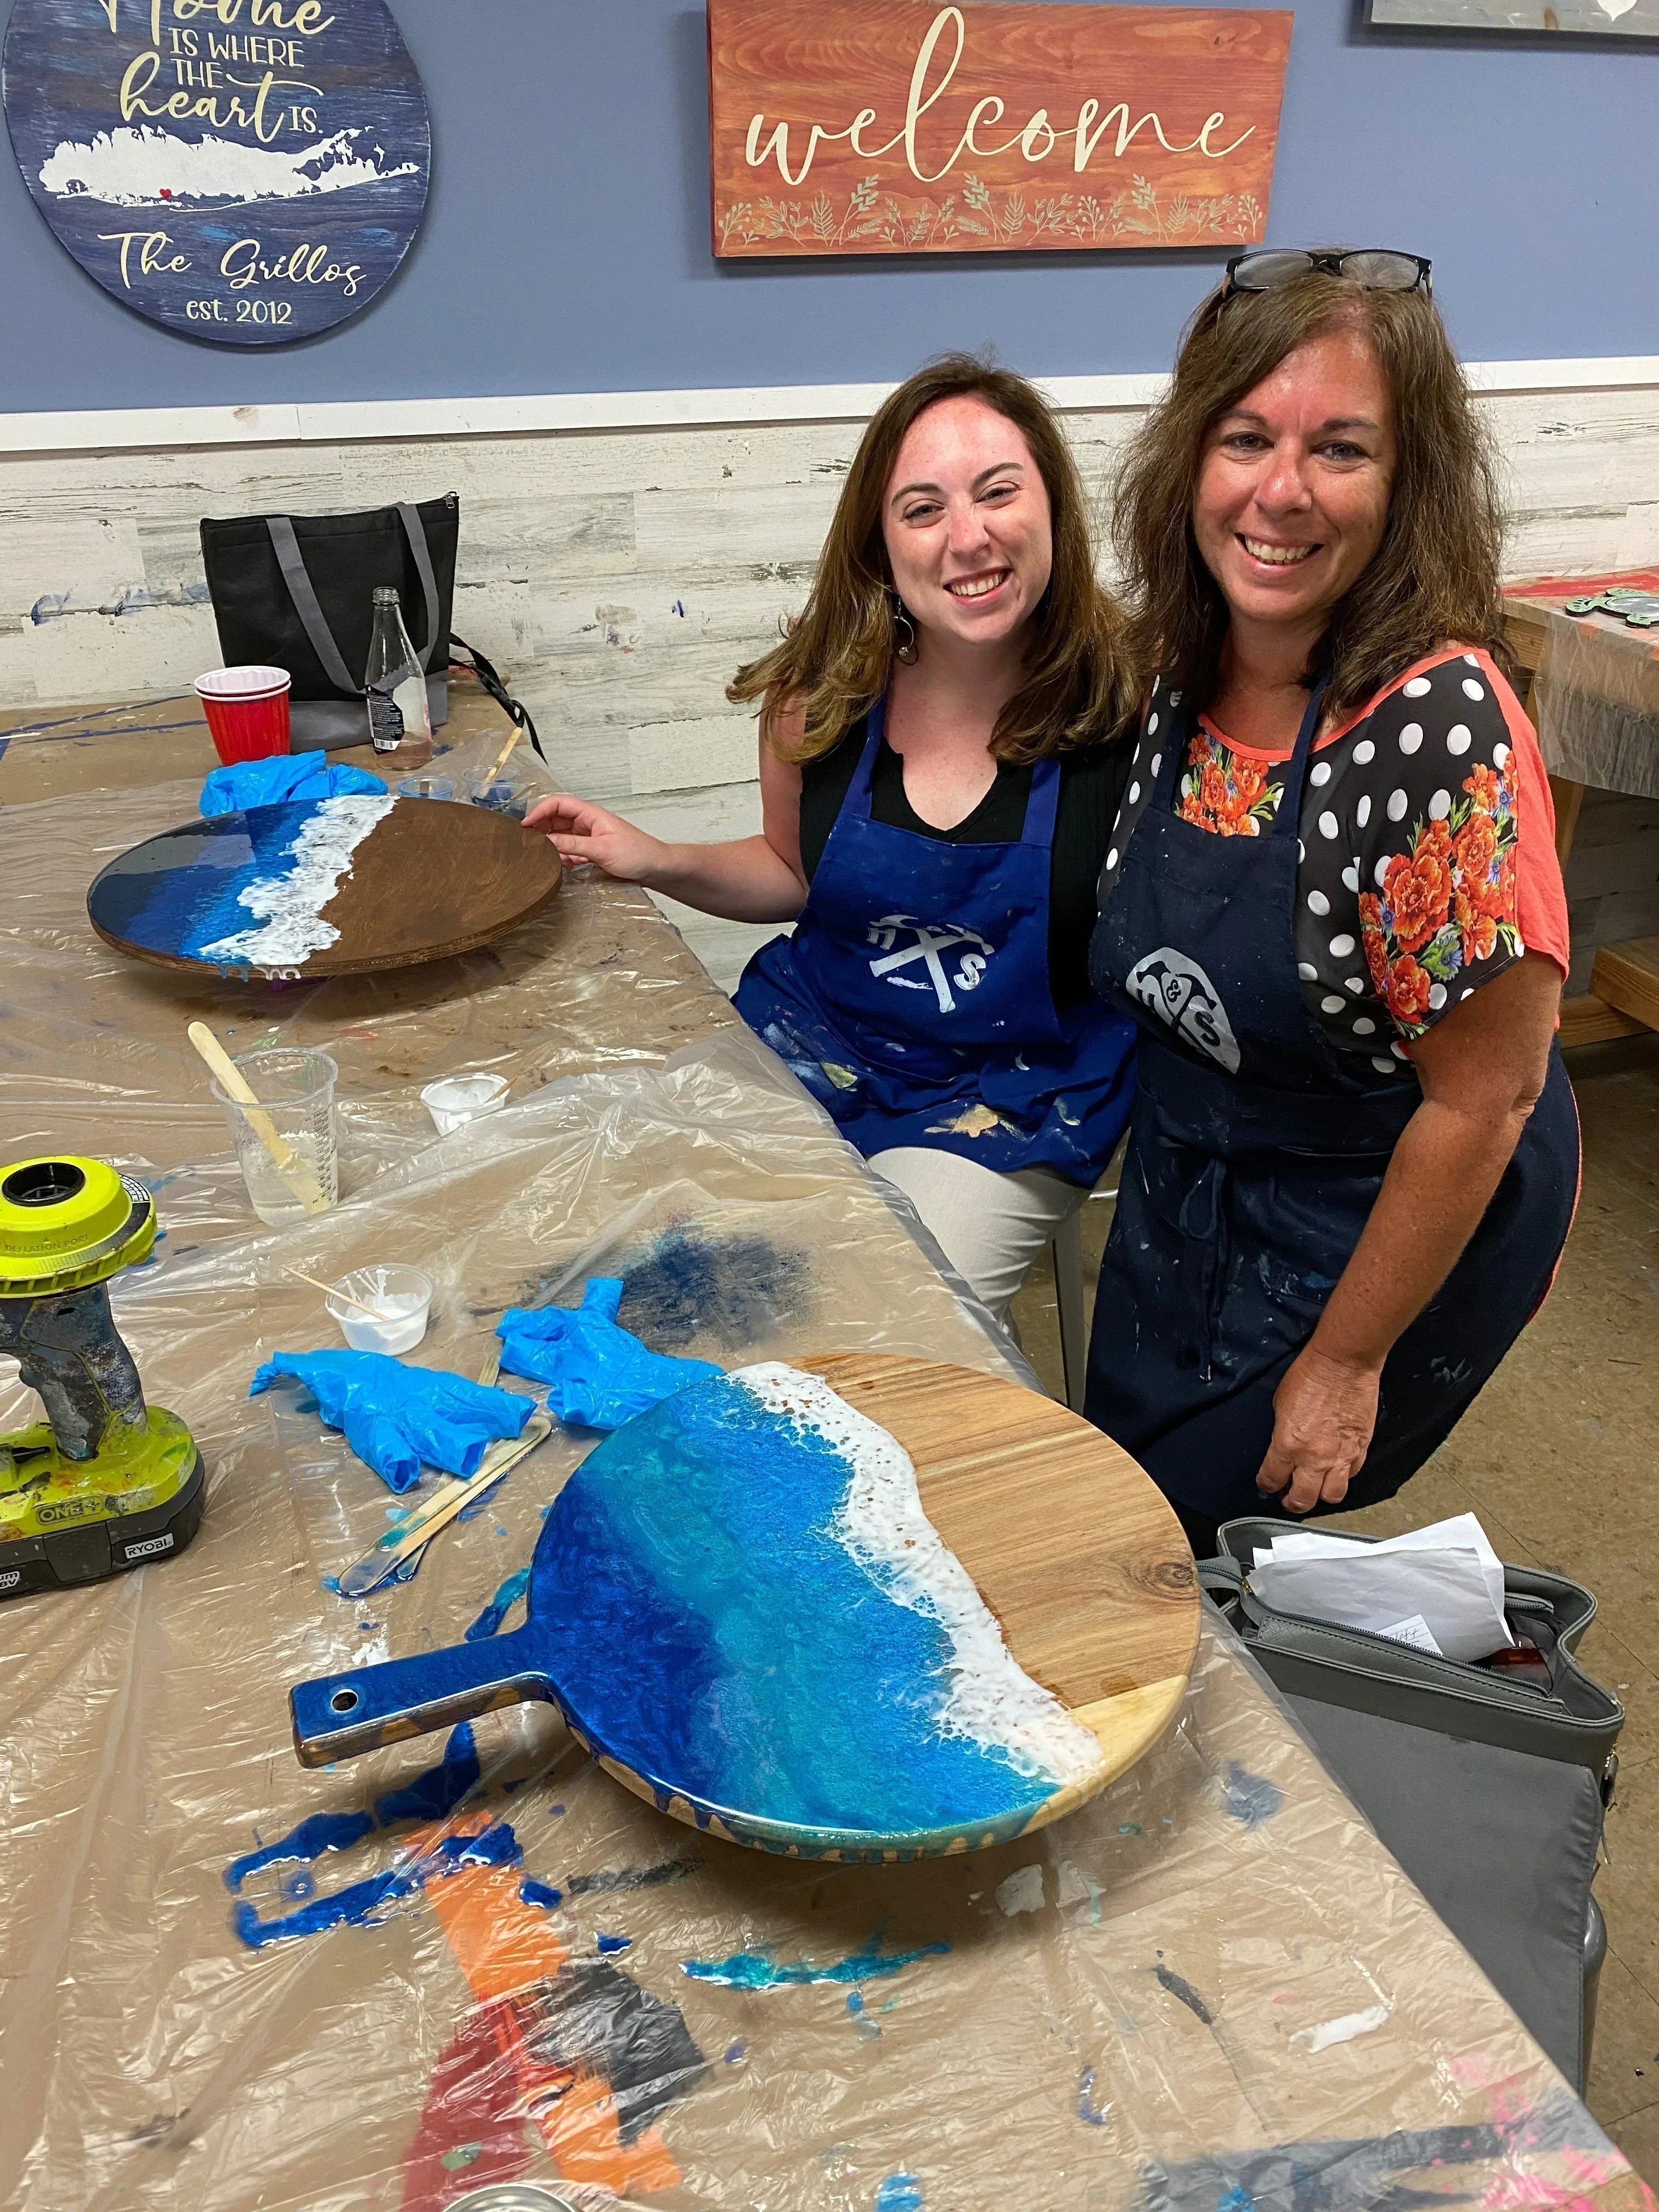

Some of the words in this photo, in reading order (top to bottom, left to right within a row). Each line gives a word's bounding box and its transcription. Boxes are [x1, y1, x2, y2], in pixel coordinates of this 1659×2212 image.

[168, 28, 199, 57] IS
[208, 32, 305, 68] WHERE
[170, 58, 223, 89] THE
[120, 52, 324, 143] heart
[288, 106, 324, 133] IS.
[745, 6, 1256, 185] welcome
[97, 231, 192, 289] The
[221, 238, 367, 296] Grillos
[185, 299, 228, 322] est.
[236, 300, 292, 325] 2012
[5, 1243, 61, 1253] DEFLATION
[64, 1233, 89, 1248] PORT
